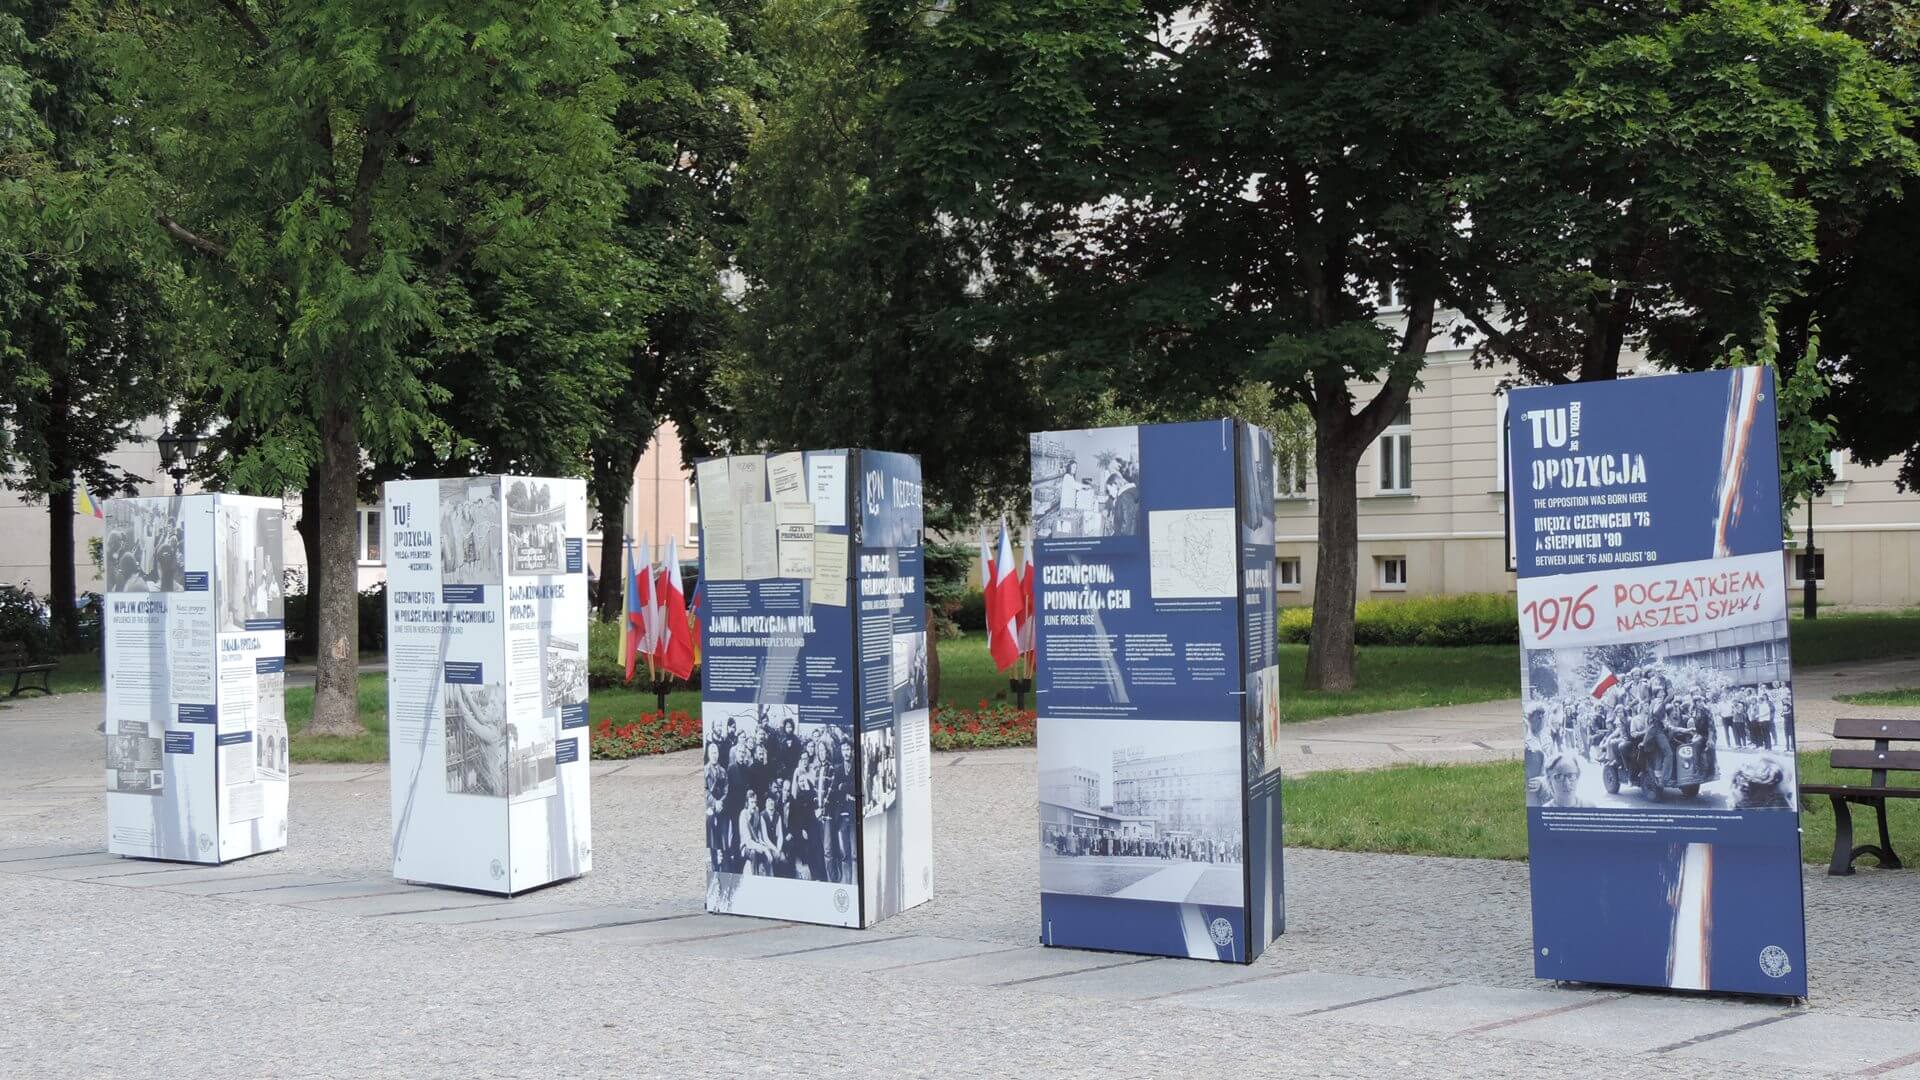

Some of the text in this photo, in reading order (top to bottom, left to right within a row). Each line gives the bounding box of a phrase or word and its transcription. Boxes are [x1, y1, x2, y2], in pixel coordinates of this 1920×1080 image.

[1527, 408, 1567, 449] TU
[1532, 453, 1647, 490] OPOZYCJA
[1534, 492, 1648, 509] THE OPPOSITION WAS BORN HERE
[393, 505, 406, 525] TU
[1534, 516, 1571, 534] MIĘDZY
[1573, 513, 1631, 530] CZERWCEM
[394, 531, 432, 547] OPOZYCJA
[1536, 537, 1543, 551] A
[1545, 533, 1601, 550] SIERPNIEM
[1536, 555, 1567, 566] BETWEEN
[1568, 553, 1584, 565] JUNE
[1598, 552, 1613, 563] AND
[1615, 551, 1643, 562] AUGUST
[1043, 564, 1115, 584] CZERWCOWA
[1044, 585, 1106, 610] PODWYŻKA
[1107, 589, 1131, 610] CEN
[1044, 614, 1060, 626] JUNE
[1060, 614, 1079, 625] PRICE
[1523, 584, 1598, 641] 1976
[1616, 604, 1699, 632] NASZEJ
[709, 615, 741, 633] JAWNA
[741, 615, 788, 633] OPOZYCJA
[787, 615, 797, 633] W
